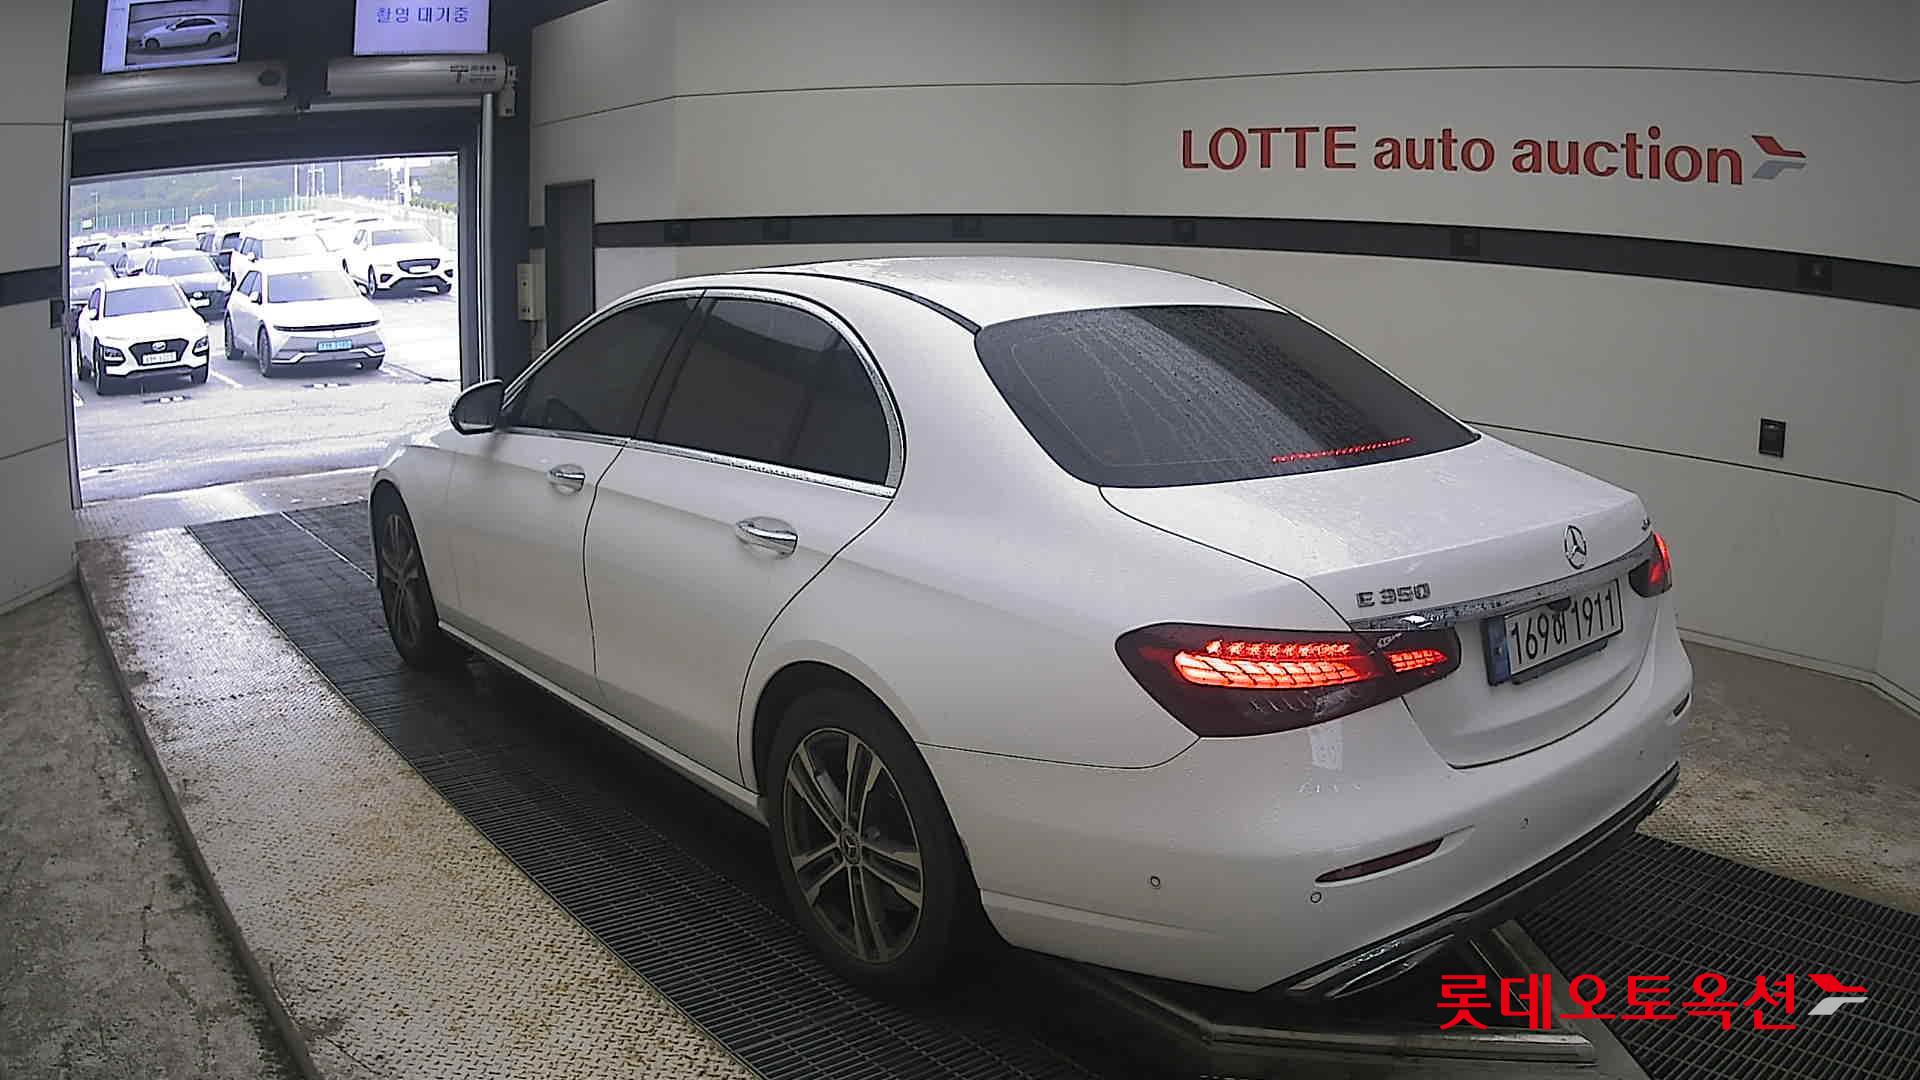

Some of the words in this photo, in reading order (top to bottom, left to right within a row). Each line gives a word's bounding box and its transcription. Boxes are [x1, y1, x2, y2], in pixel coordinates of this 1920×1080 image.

[418, 7, 468, 23] 대기중
[1182, 126, 1357, 170] LOTTE
[1374, 128, 1495, 172] auto
[1512, 126, 1743, 185] auction
[1356, 591, 1375, 608] E
[1379, 583, 1430, 604] 350
